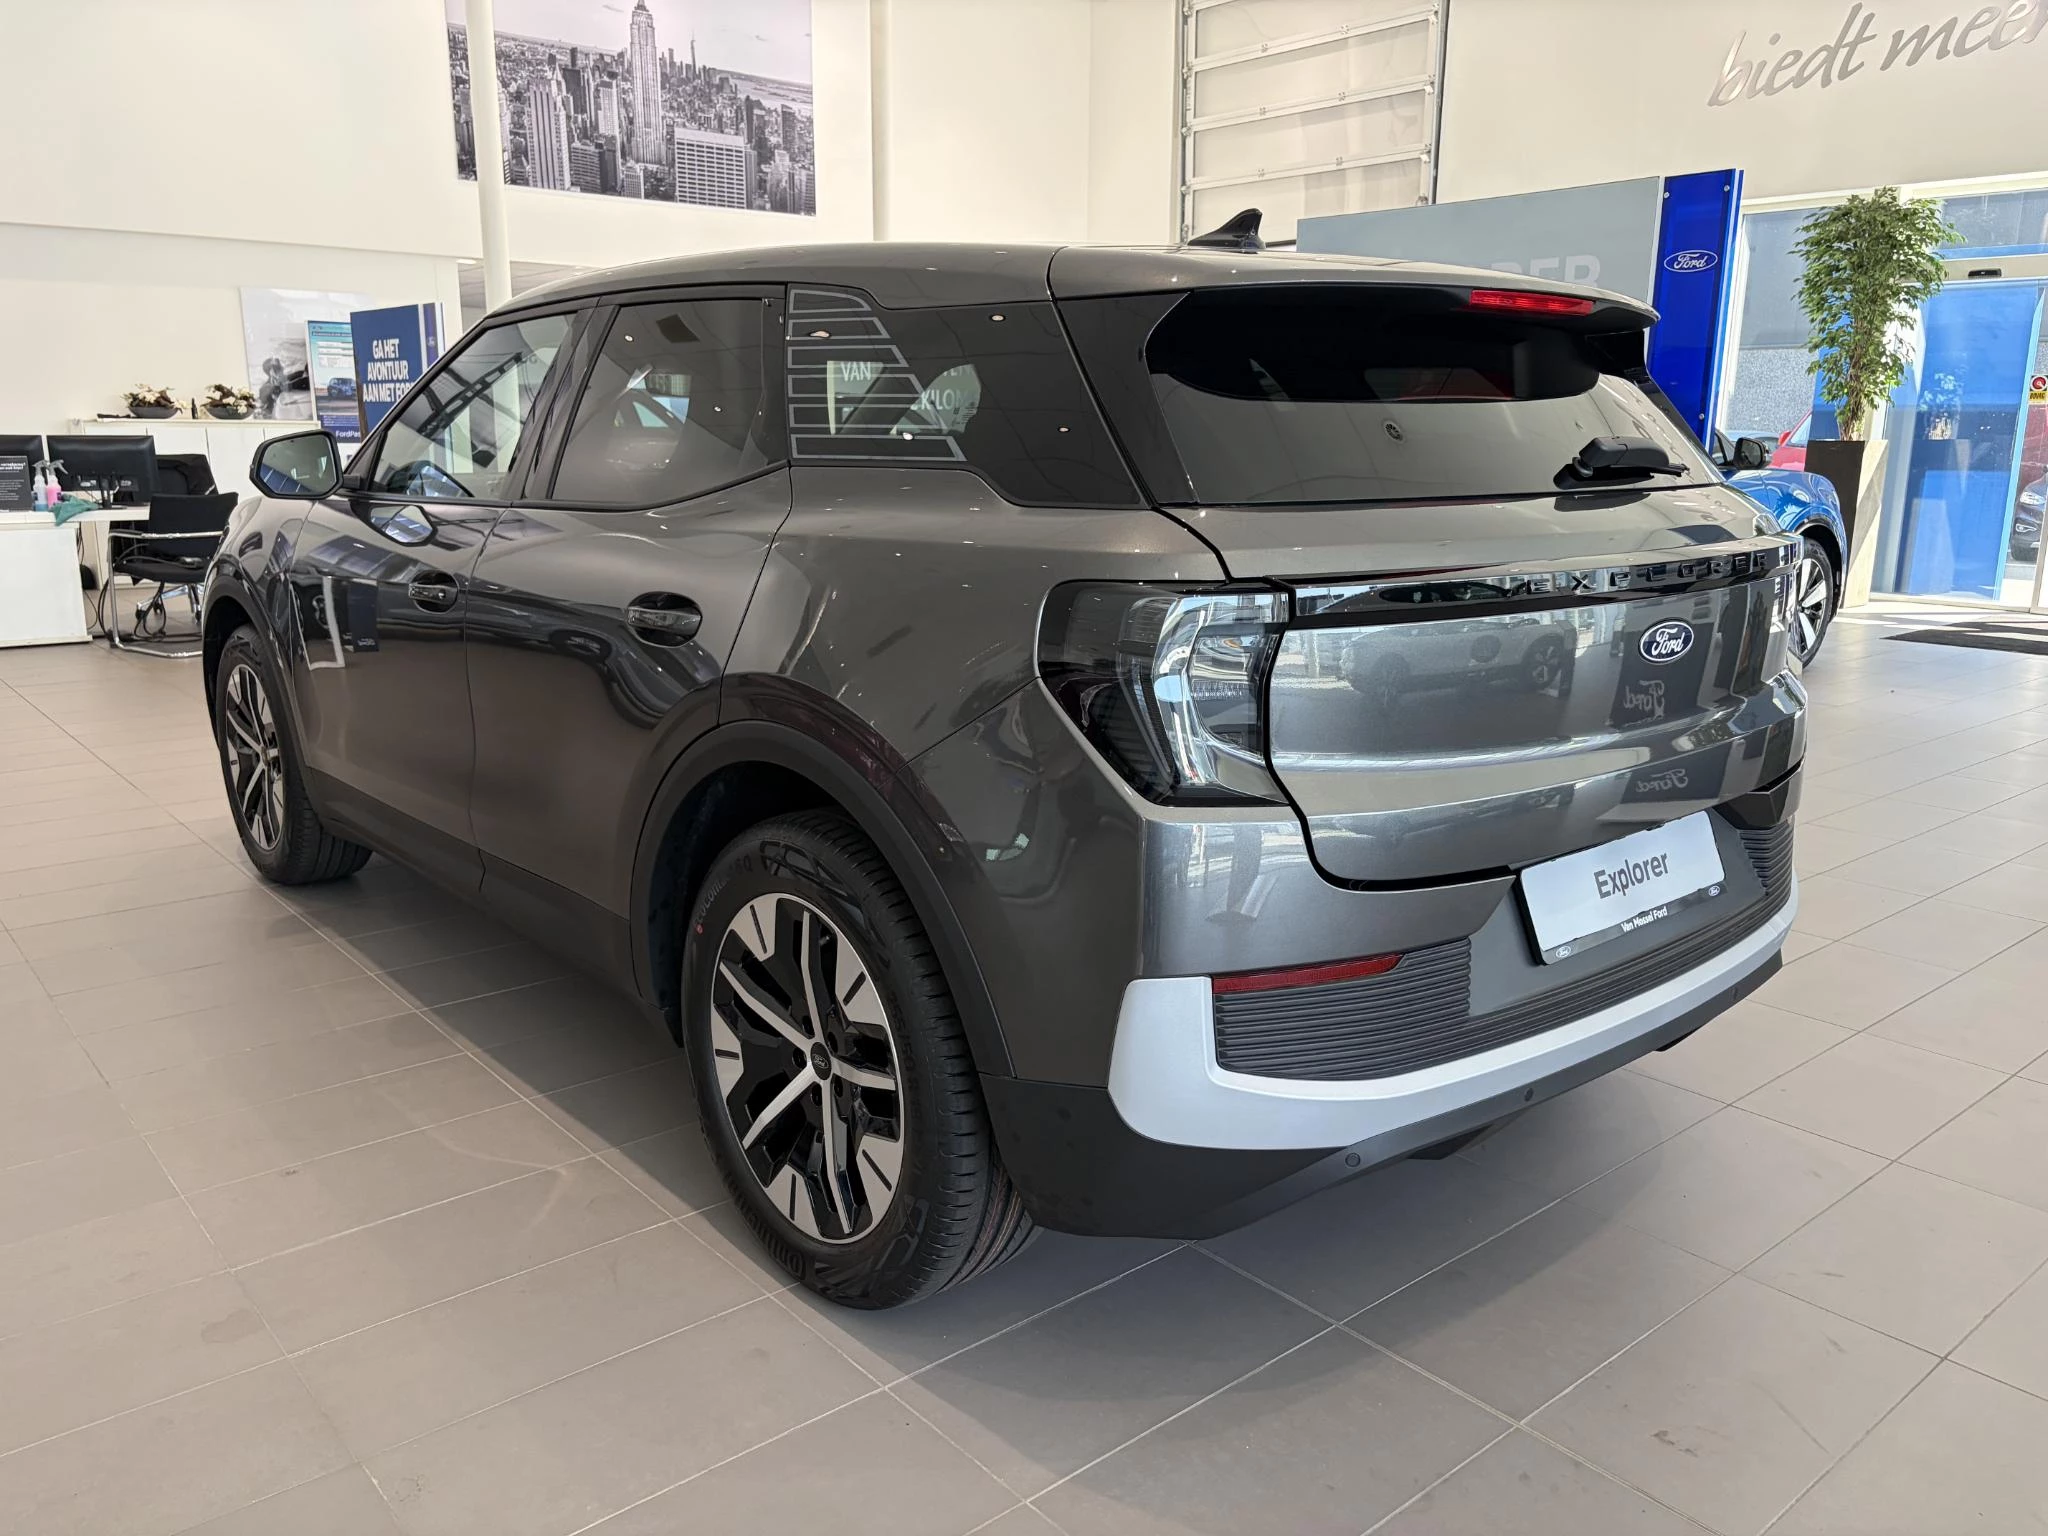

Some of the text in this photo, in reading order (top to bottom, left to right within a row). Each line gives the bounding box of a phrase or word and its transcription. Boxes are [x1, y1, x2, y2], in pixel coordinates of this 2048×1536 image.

[1707, 2, 1877, 107] biedt
[1673, 254, 1708, 270] Ford
[373, 338, 400, 359] GA HET
[367, 360, 409, 381] AVONTUUR
[841, 362, 872, 382] VAN
[362, 382, 415, 402] AAN MET FOR
[1526, 552, 1768, 593] EXPLORER
[1651, 627, 1685, 656] Ford
[1593, 852, 1669, 899] Explorer
[1620, 921, 1634, 933] Van
[1653, 905, 1668, 920] Ford
